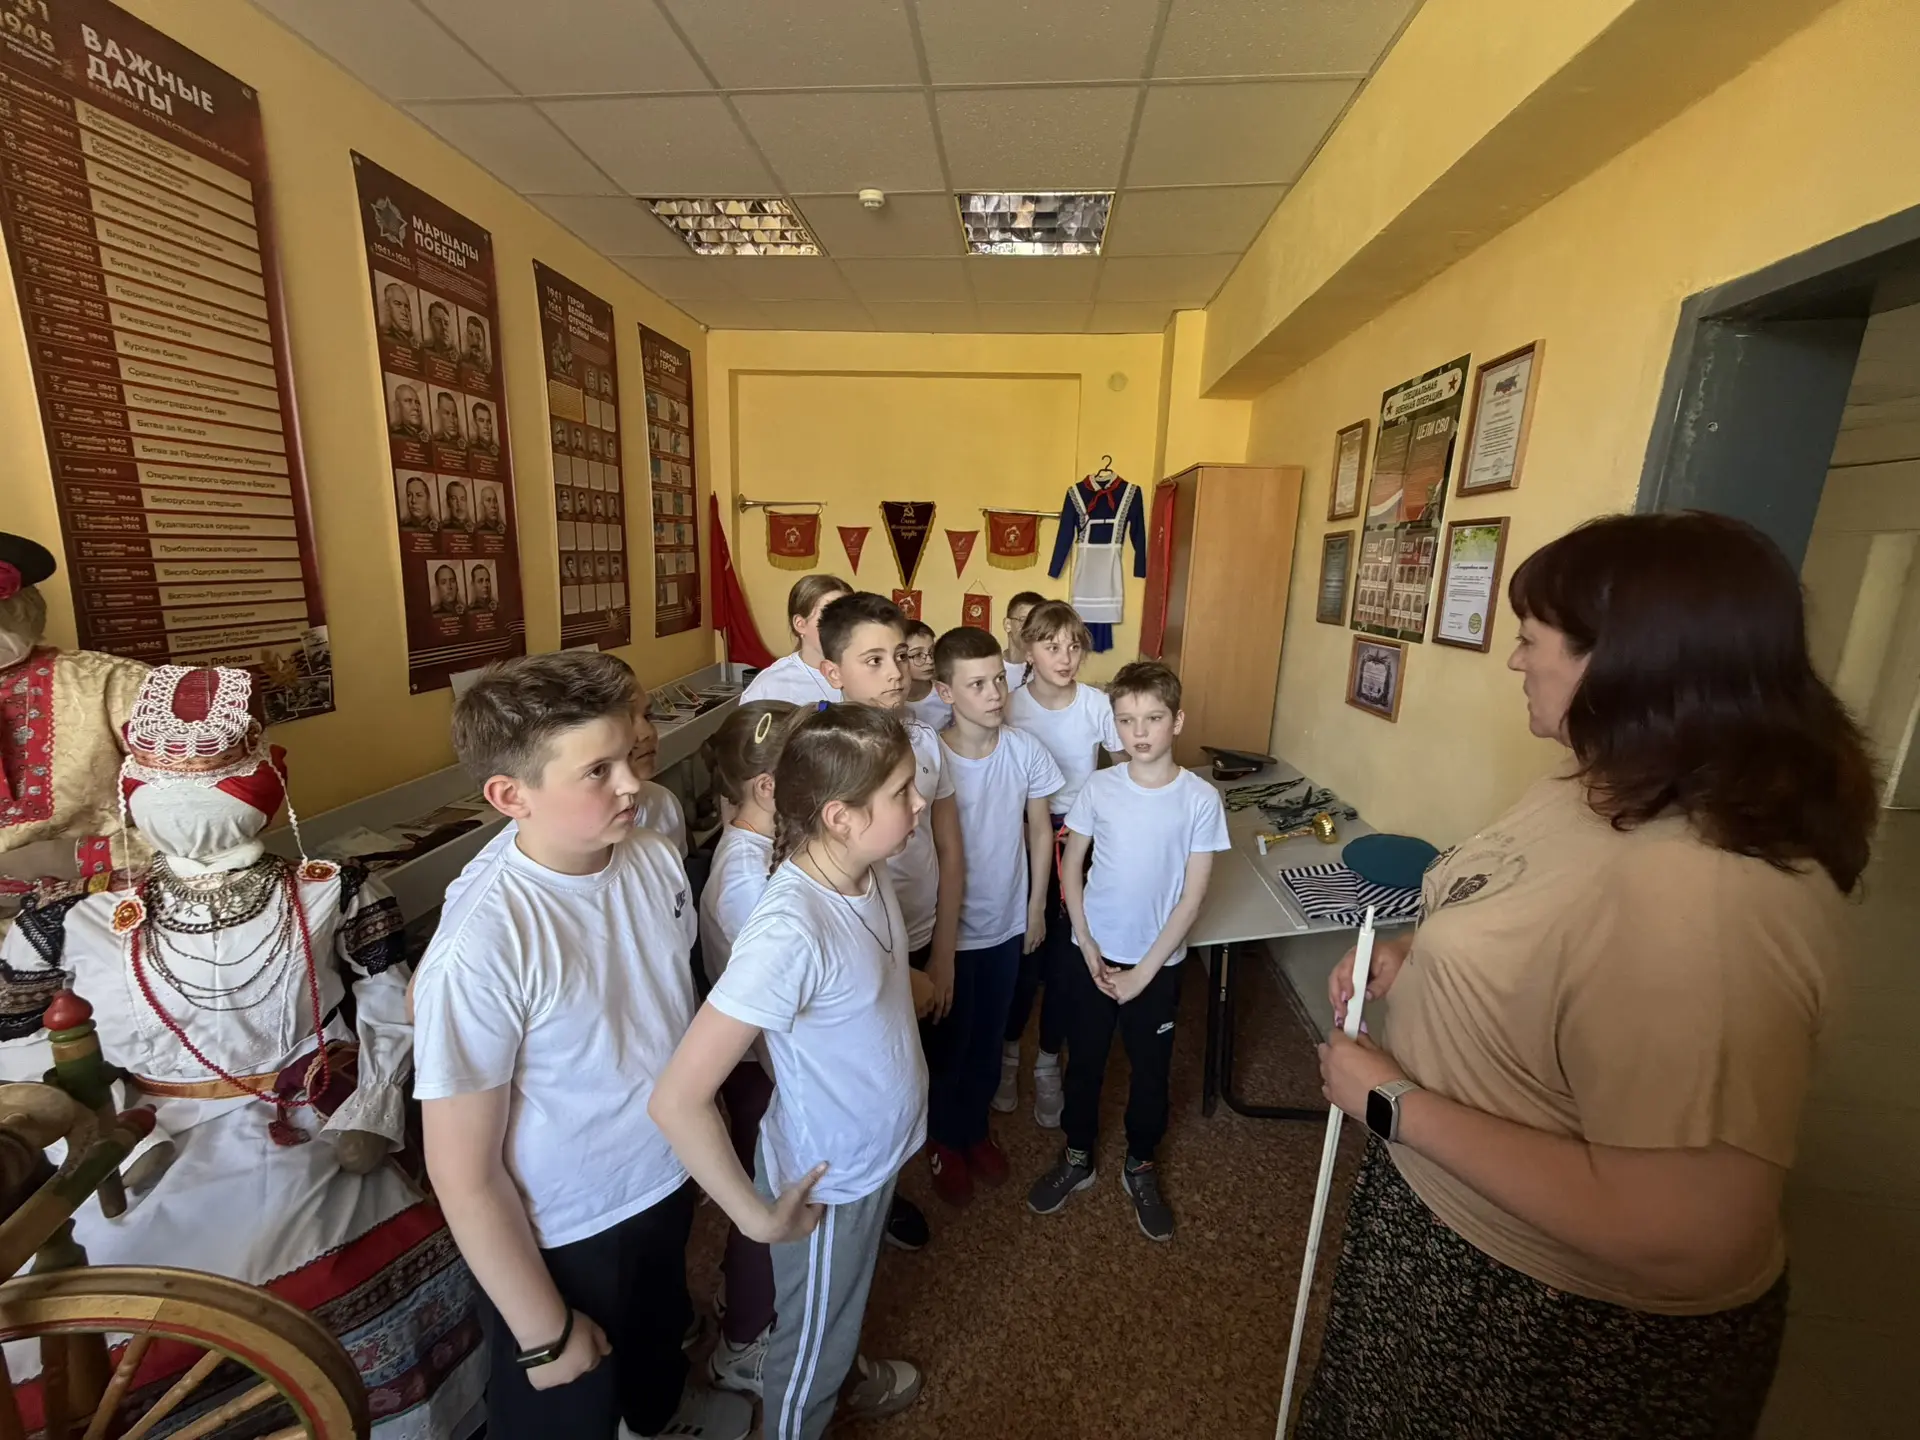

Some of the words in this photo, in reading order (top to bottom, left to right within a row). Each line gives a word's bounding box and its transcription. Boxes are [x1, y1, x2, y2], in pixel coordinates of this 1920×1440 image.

[81, 23, 214, 115] ВАЖНЫЕ
[86, 53, 173, 116] ДАТЫ
[105, 228, 147, 249] Блокада
[412, 214, 480, 263] МАРШАЛЫ
[373, 242, 391, 257] 1941
[414, 230, 468, 270] ПОБЕДЫ
[110, 256, 139, 273] Битва
[152, 270, 188, 289] Москву
[115, 285, 175, 310] Героическая
[175, 303, 211, 319] оборона
[546, 285, 563, 303] 1941
[567, 294, 586, 312] ГЕРОИ
[567, 303, 594, 326] ВЕЛИКОЙ
[119, 312, 166, 331] Ржевская
[166, 325, 192, 339] битва
[568, 314, 610, 343] ОТЕЧЕСТВЕННОЙ
[568, 324, 590, 341] ВОЙНЫ
[123, 339, 161, 357] Курская
[162, 349, 188, 362] битва
[128, 366, 173, 383] Сражение
[174, 376, 189, 386] под
[660, 359, 676, 374] ГЕРОИ
[1403, 379, 1438, 402] СПЕЦИАЛЬНАЯ
[132, 393, 203, 413] Сталинградская
[204, 405, 228, 417] битва
[1395, 399, 1416, 415] ВОЕННАЯ
[1415, 388, 1443, 408] ОПЕРАЦИЯ
[137, 419, 164, 430] Битва
[166, 424, 176, 432] за
[177, 425, 207, 437] Кавказ
[1416, 420, 1435, 441] ЦЕЛИ
[1435, 416, 1450, 435] СВО
[142, 445, 168, 456] Битва
[169, 449, 179, 457] за
[180, 449, 243, 465] Правобережную
[146, 470, 187, 482] Открытие
[188, 475, 219, 485] второго
[219, 476, 246, 487] фронта
[151, 495, 205, 506] Белорусская
[206, 499, 243, 508] операция
[155, 520, 214, 530] Будапештская
[215, 523, 251, 532] операция
[159, 544, 222, 554] Прибалтийская
[223, 546, 258, 555] операция
[163, 567, 230, 577] Висло-Одерская
[230, 567, 265, 576] операция
[167, 589, 241, 601] Восточно-Прусская
[171, 613, 220, 624] Берлинская
[220, 610, 256, 621] операция
[135, 640, 161, 651] 1945
[174, 631, 222, 643] Подписание
[210, 653, 253, 667] Победы
